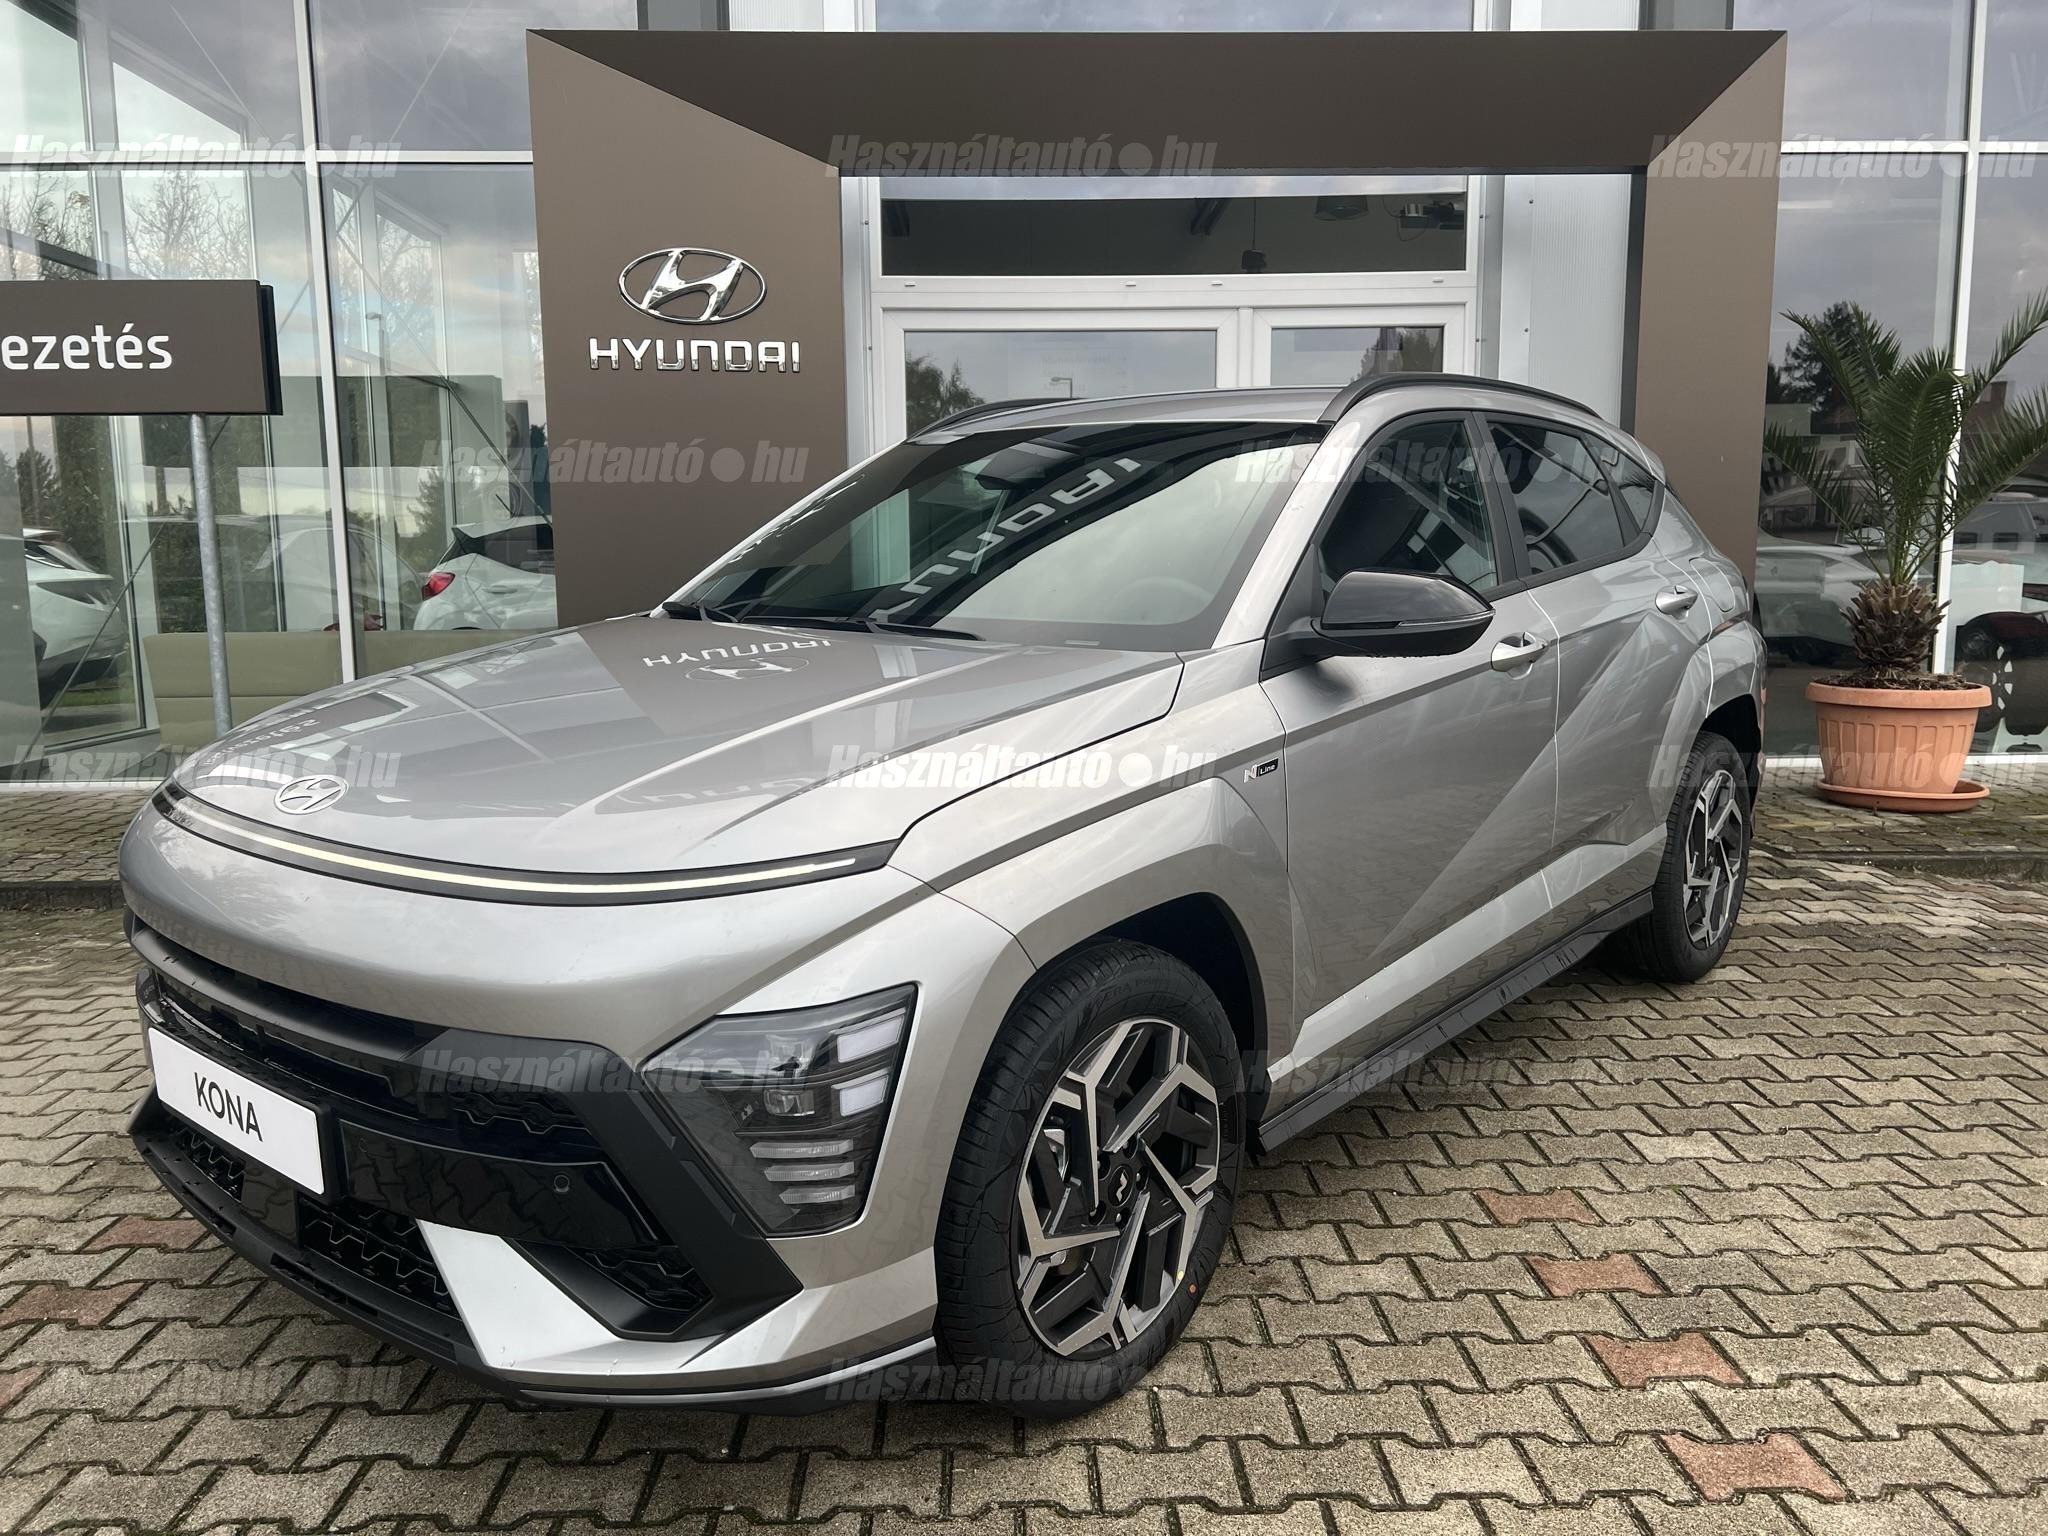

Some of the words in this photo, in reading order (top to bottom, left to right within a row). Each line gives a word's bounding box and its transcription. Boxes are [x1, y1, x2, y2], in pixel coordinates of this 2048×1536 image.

[1, 323, 173, 370] ezetés
[589, 337, 800, 373] HYUNDAI
[194, 1072, 263, 1142] KONA
